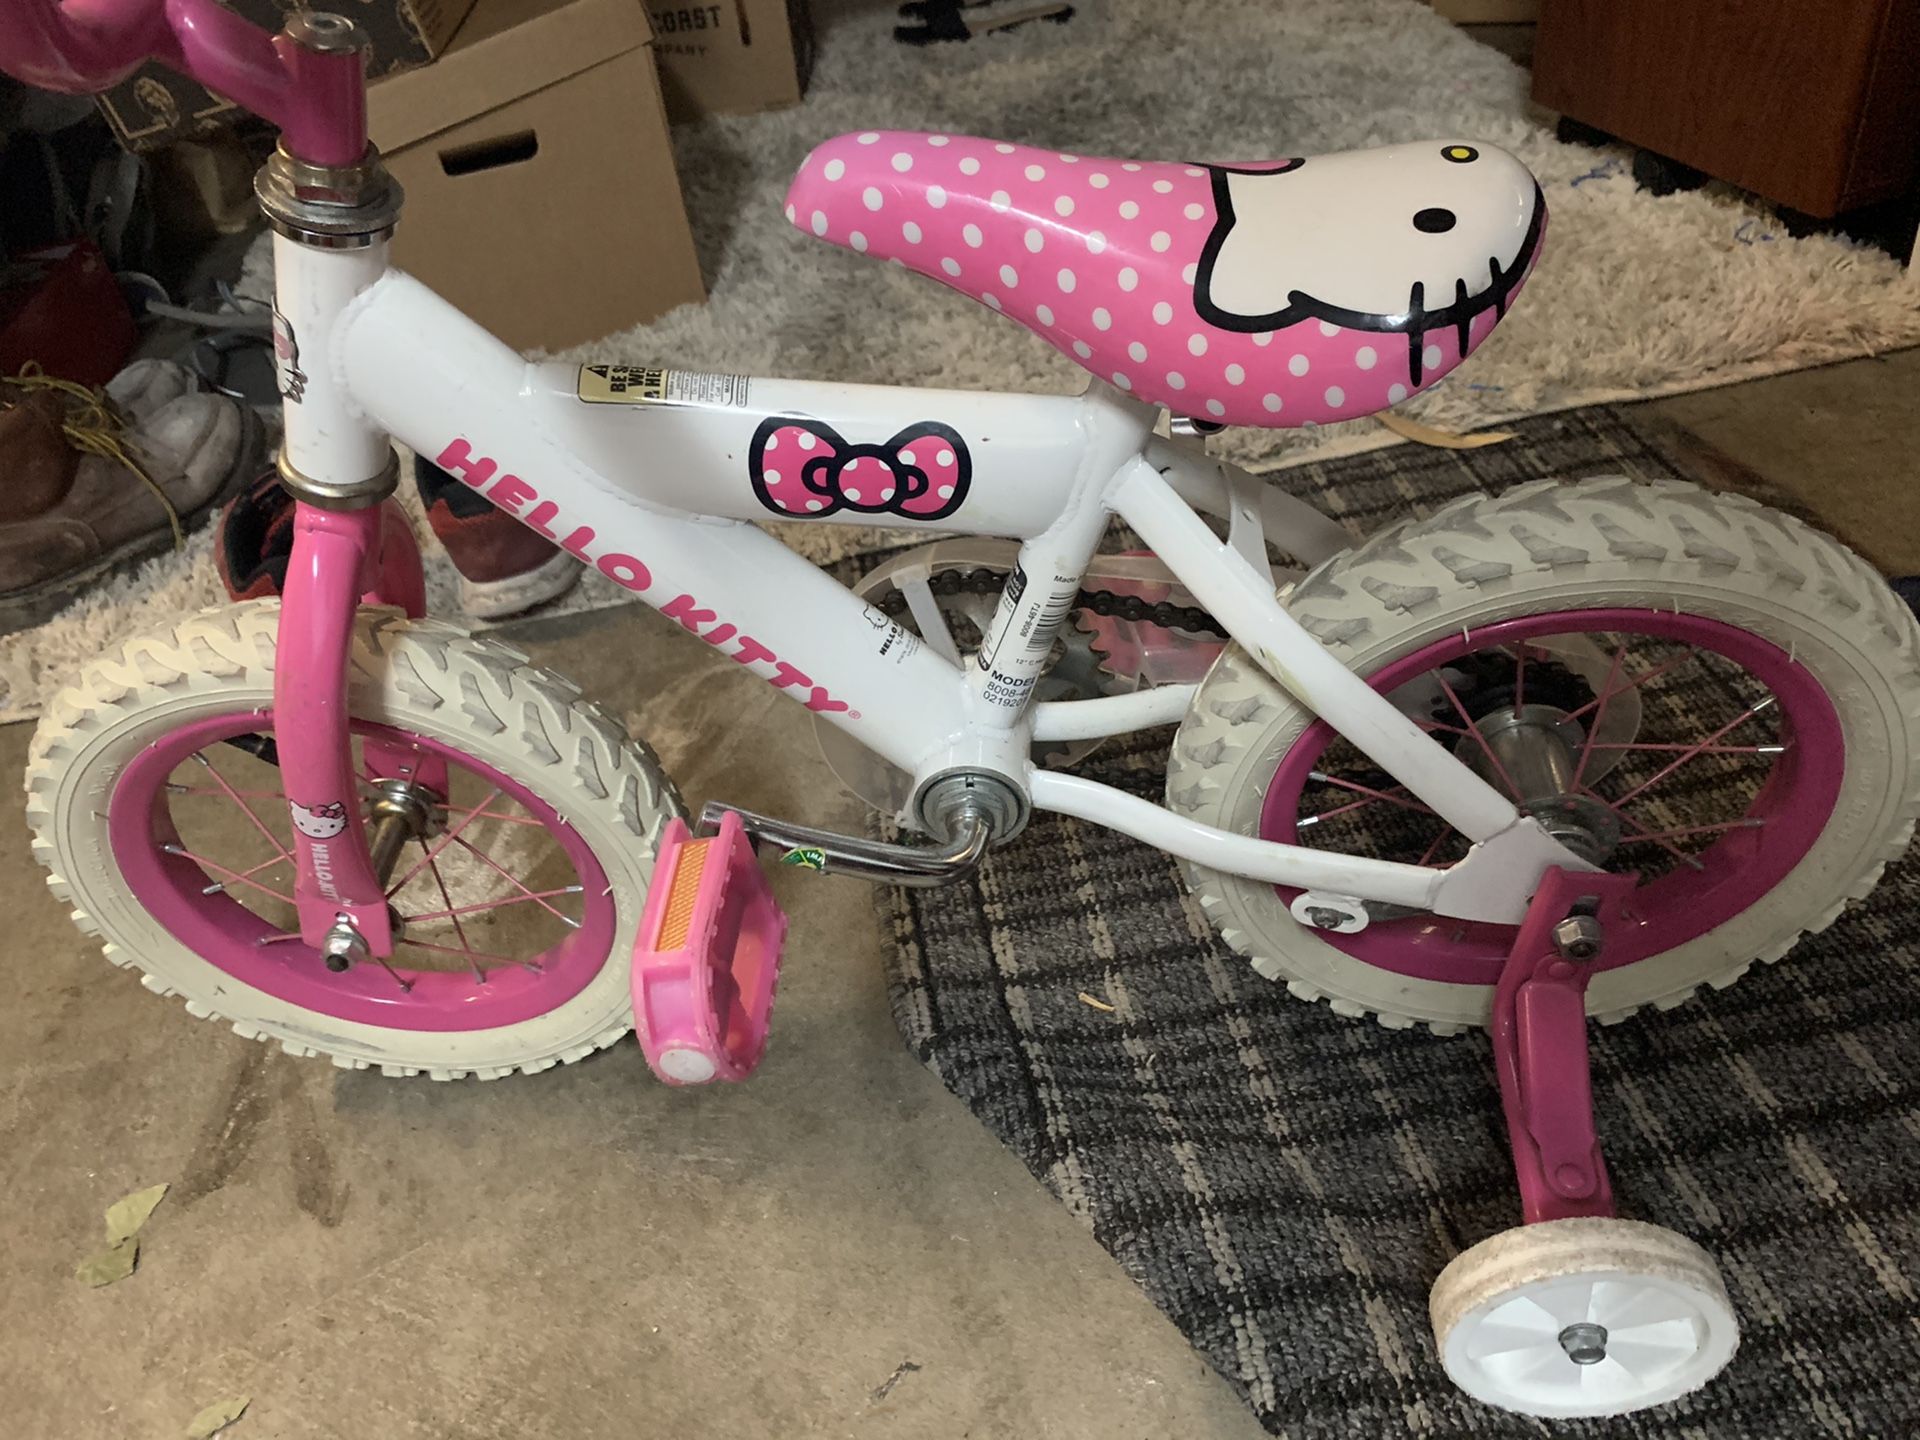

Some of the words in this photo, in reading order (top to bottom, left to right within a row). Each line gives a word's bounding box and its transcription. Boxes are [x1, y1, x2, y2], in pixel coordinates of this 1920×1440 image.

[610, 375, 627, 392] BE
[644, 391, 660, 399] A
[436, 438, 652, 591] HELLO
[659, 594, 849, 713] KITTY
[1053, 575, 1077, 584] Made
[879, 626, 898, 656] HELLO
[310, 842, 334, 881] HELLO
